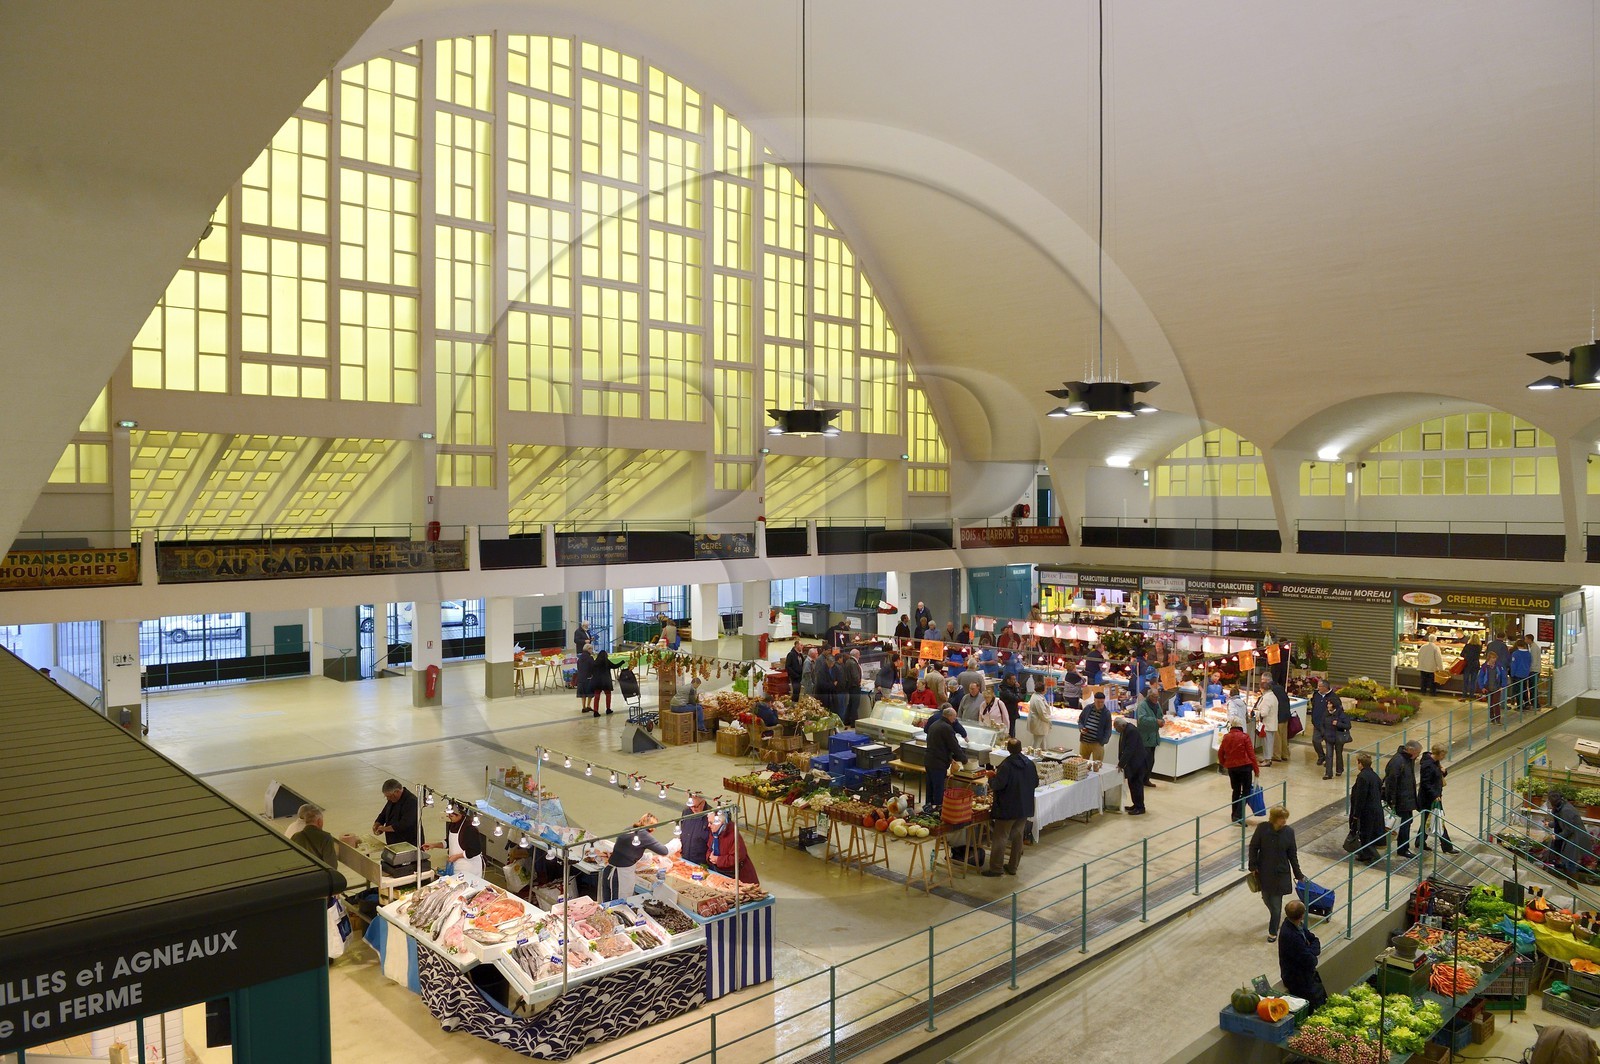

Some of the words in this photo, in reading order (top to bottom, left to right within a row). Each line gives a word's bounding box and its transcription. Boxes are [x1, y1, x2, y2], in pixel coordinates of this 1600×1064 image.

[961, 530, 977, 541] BOIS
[1018, 535, 1029, 543] 20
[7, 552, 129, 566] TRANSPORTS
[215, 558, 248, 576] AU
[261, 555, 354, 574] CADRAN
[368, 552, 423, 569] BLEU
[0, 565, 118, 578] HOUMACHER
[1080, 575, 1109, 583] CHARCUTERIE
[1110, 576, 1138, 584] ARTISANALE
[1188, 580, 1216, 589] BOUCHER
[1217, 582, 1255, 591] CHARCUTIER
[1282, 585, 1329, 595] BOUCHERIE
[1332, 588, 1352, 596] Alain
[1353, 589, 1392, 598] MOREAU
[1446, 594, 1497, 605] CREMERIE
[1499, 597, 1550, 608] VIELLARD
[76, 962, 104, 987] et
[112, 930, 238, 980] AGNEAUX
[23, 1010, 51, 1032] la
[60, 982, 143, 1024] FERME
